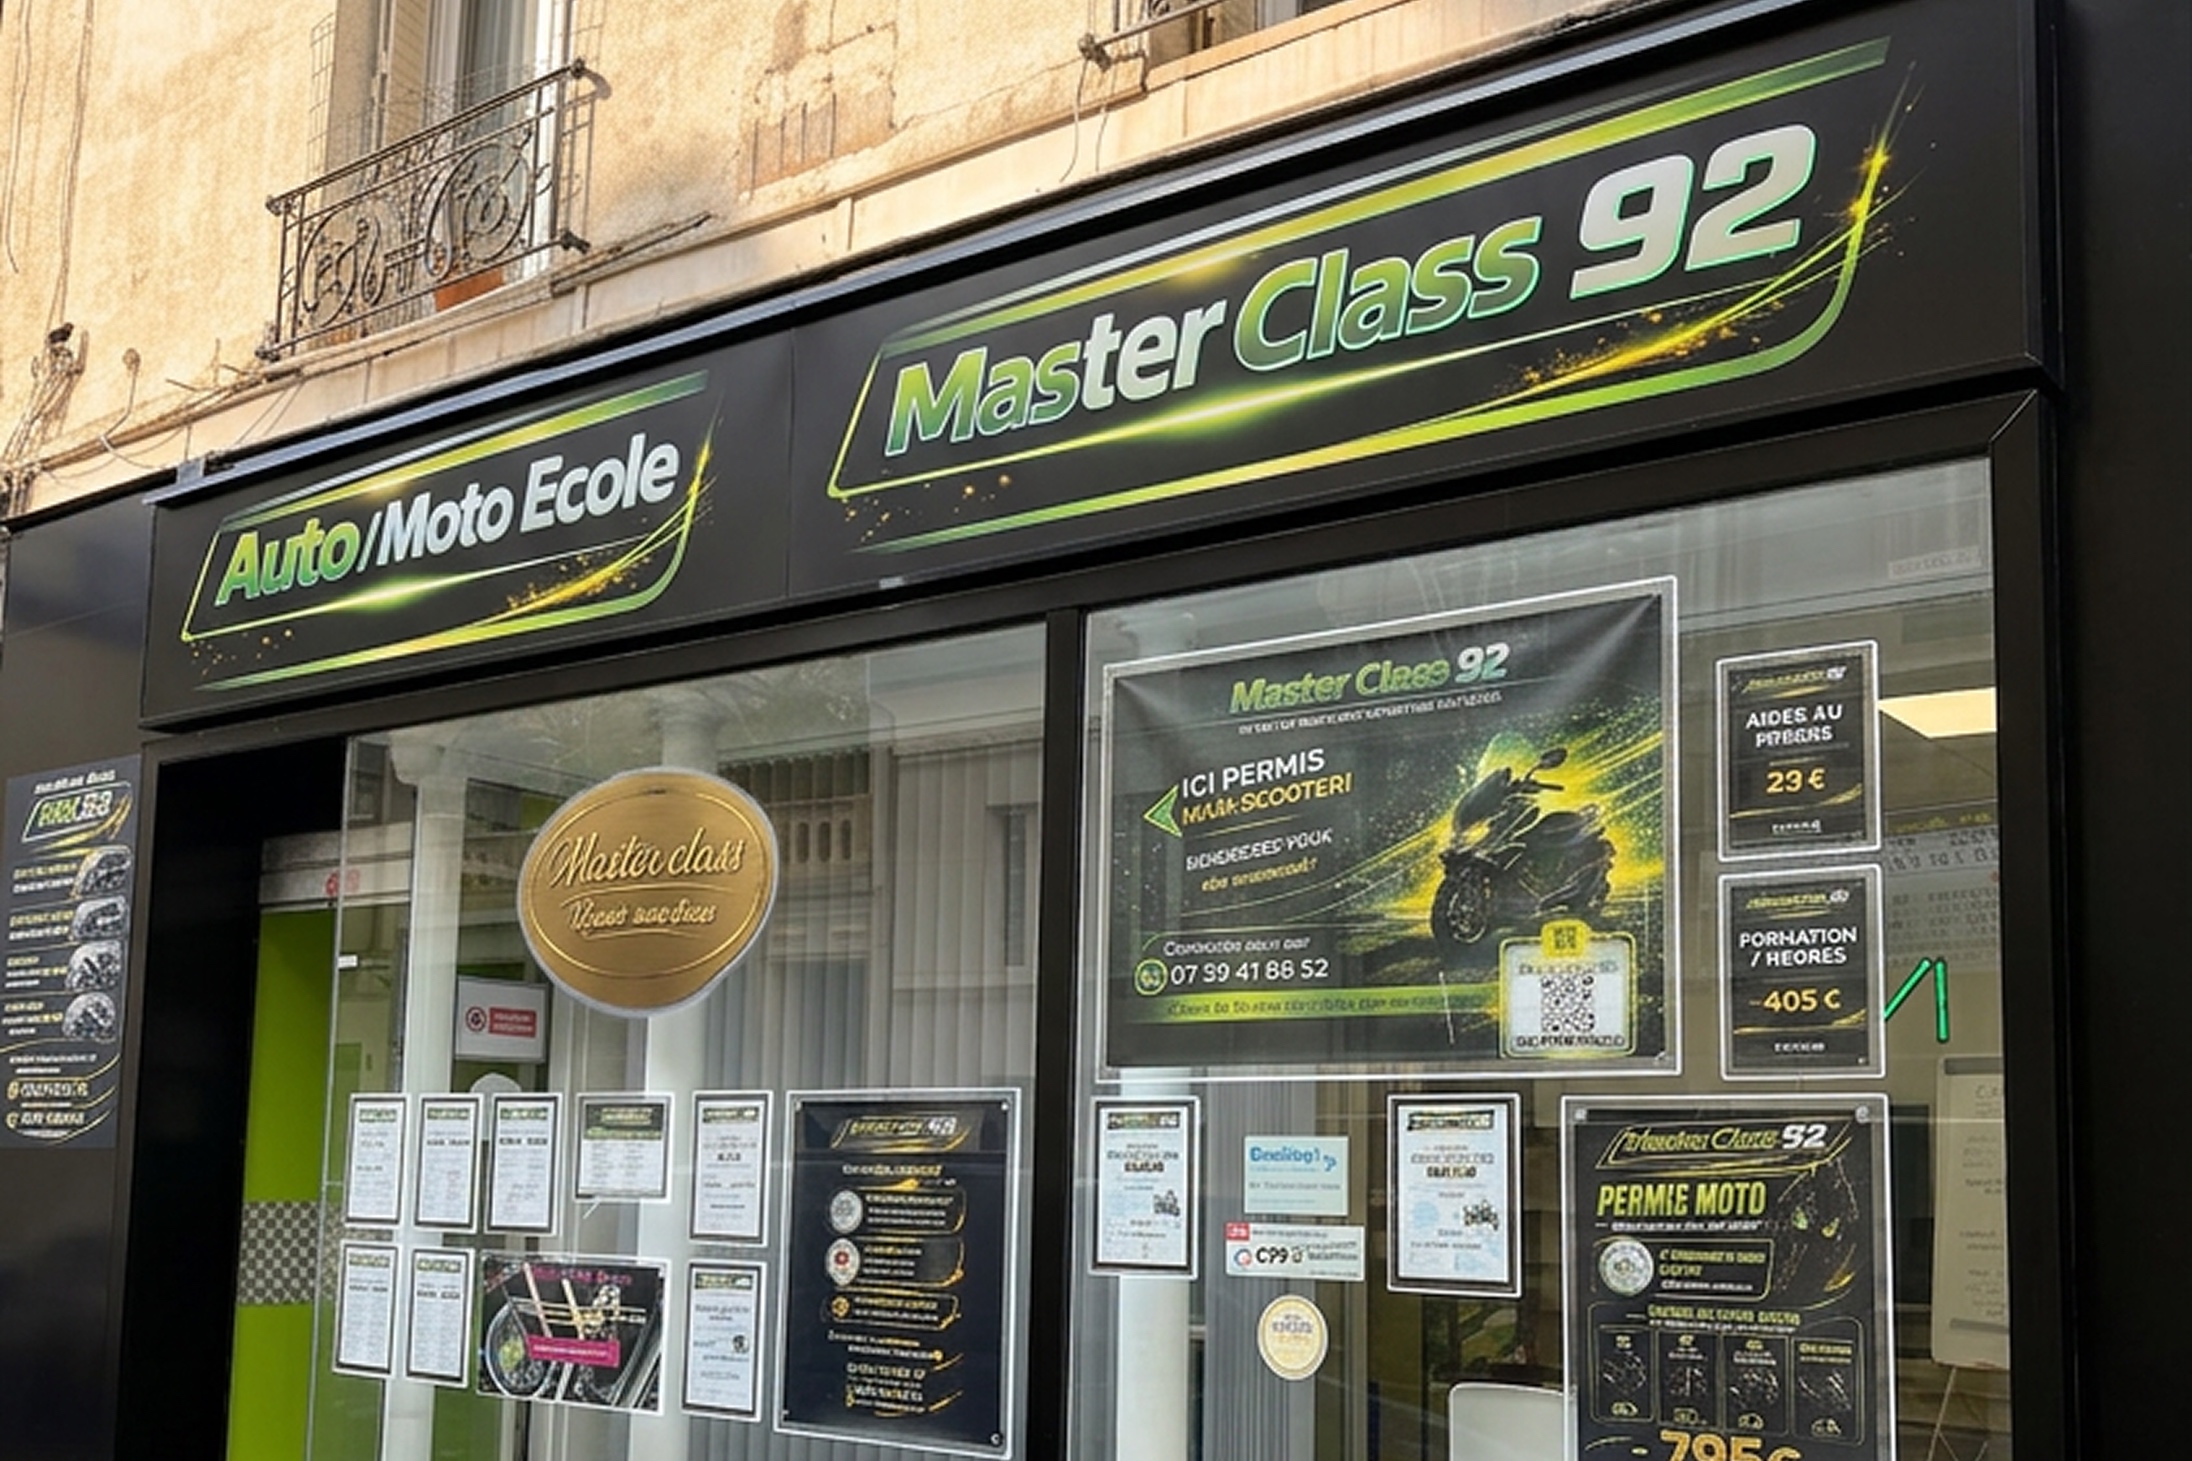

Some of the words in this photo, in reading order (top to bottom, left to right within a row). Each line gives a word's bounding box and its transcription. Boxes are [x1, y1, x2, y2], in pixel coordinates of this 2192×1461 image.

[885, 296, 1227, 458] Master
[1232, 214, 1543, 372] Class
[1568, 123, 1818, 300] 92
[519, 432, 681, 535] Ecole
[1229, 671, 1351, 714] Master
[1455, 641, 1511, 684] 92
[1813, 703, 1844, 722] AU
[1182, 770, 1216, 799] ICI
[1221, 747, 1327, 792] PERMIS
[1170, 964, 1199, 985] 07
[1234, 961, 1261, 982] 41
[1300, 957, 1330, 979] 52
